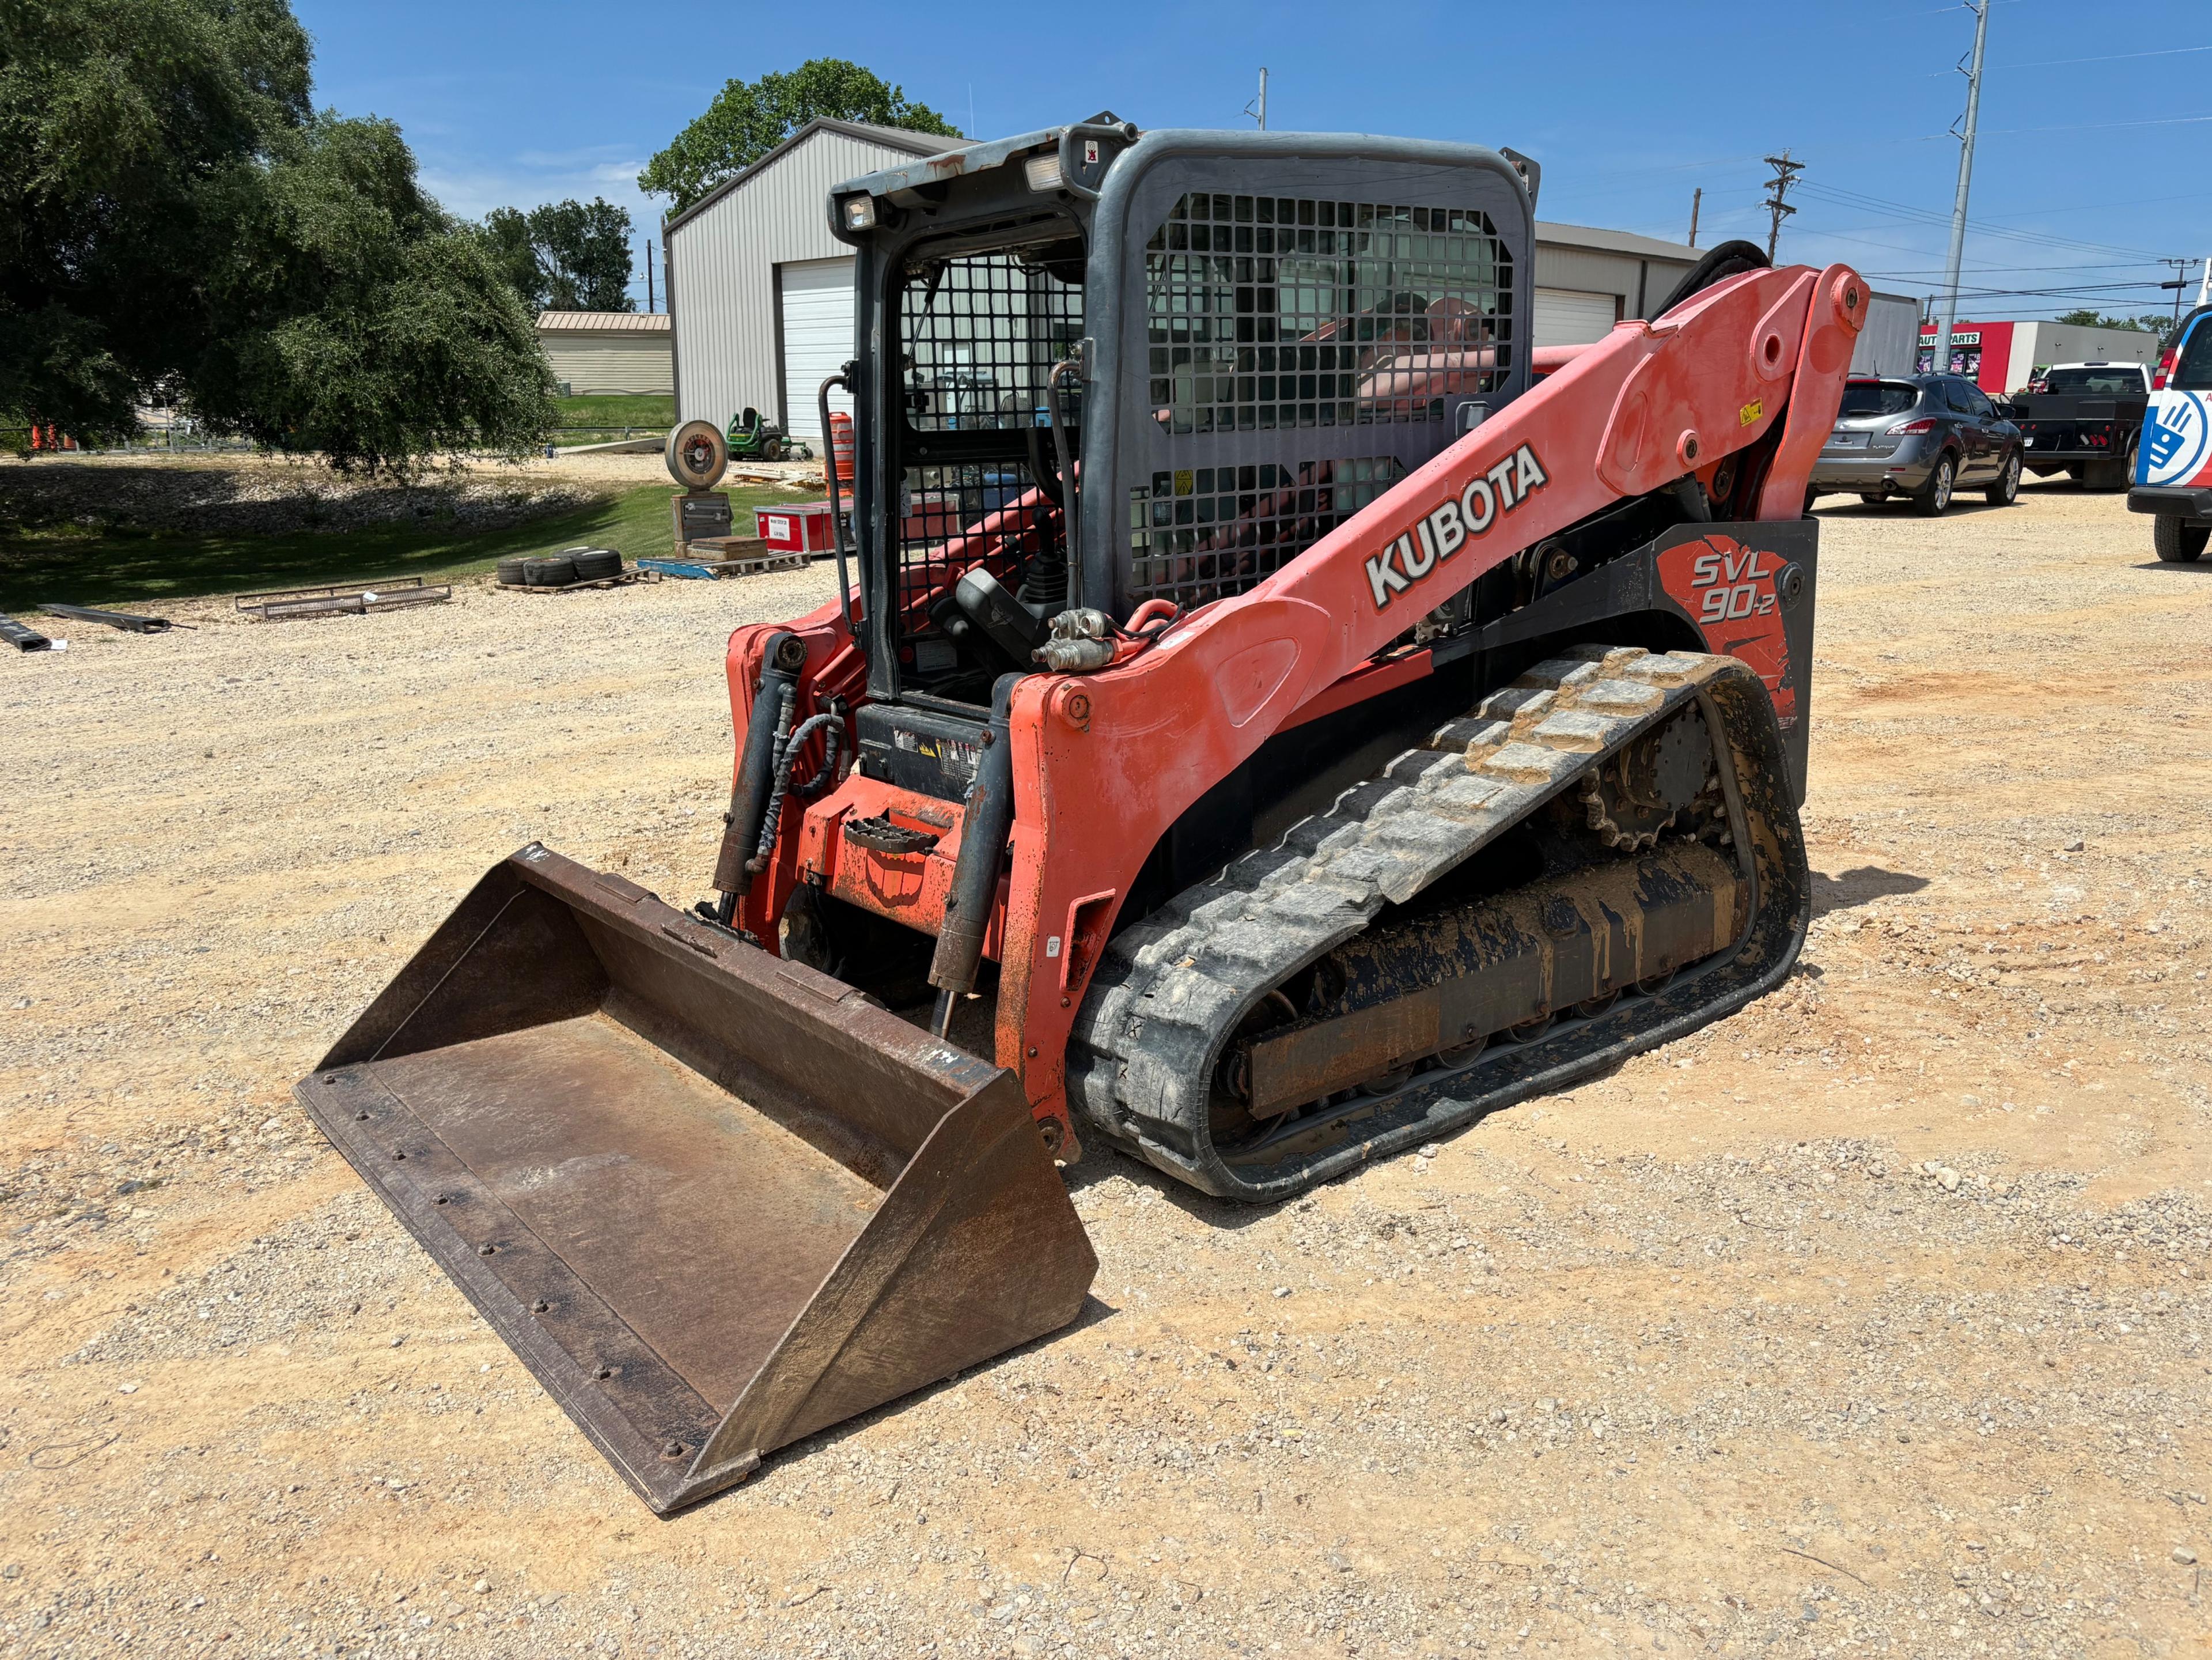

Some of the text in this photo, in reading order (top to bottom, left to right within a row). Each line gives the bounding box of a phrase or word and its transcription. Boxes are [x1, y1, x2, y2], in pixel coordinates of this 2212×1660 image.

[1919, 334, 1977, 345] AUT ARTS
[1363, 444, 1547, 608] KUBOTA
[1691, 551, 1770, 588] SVL
